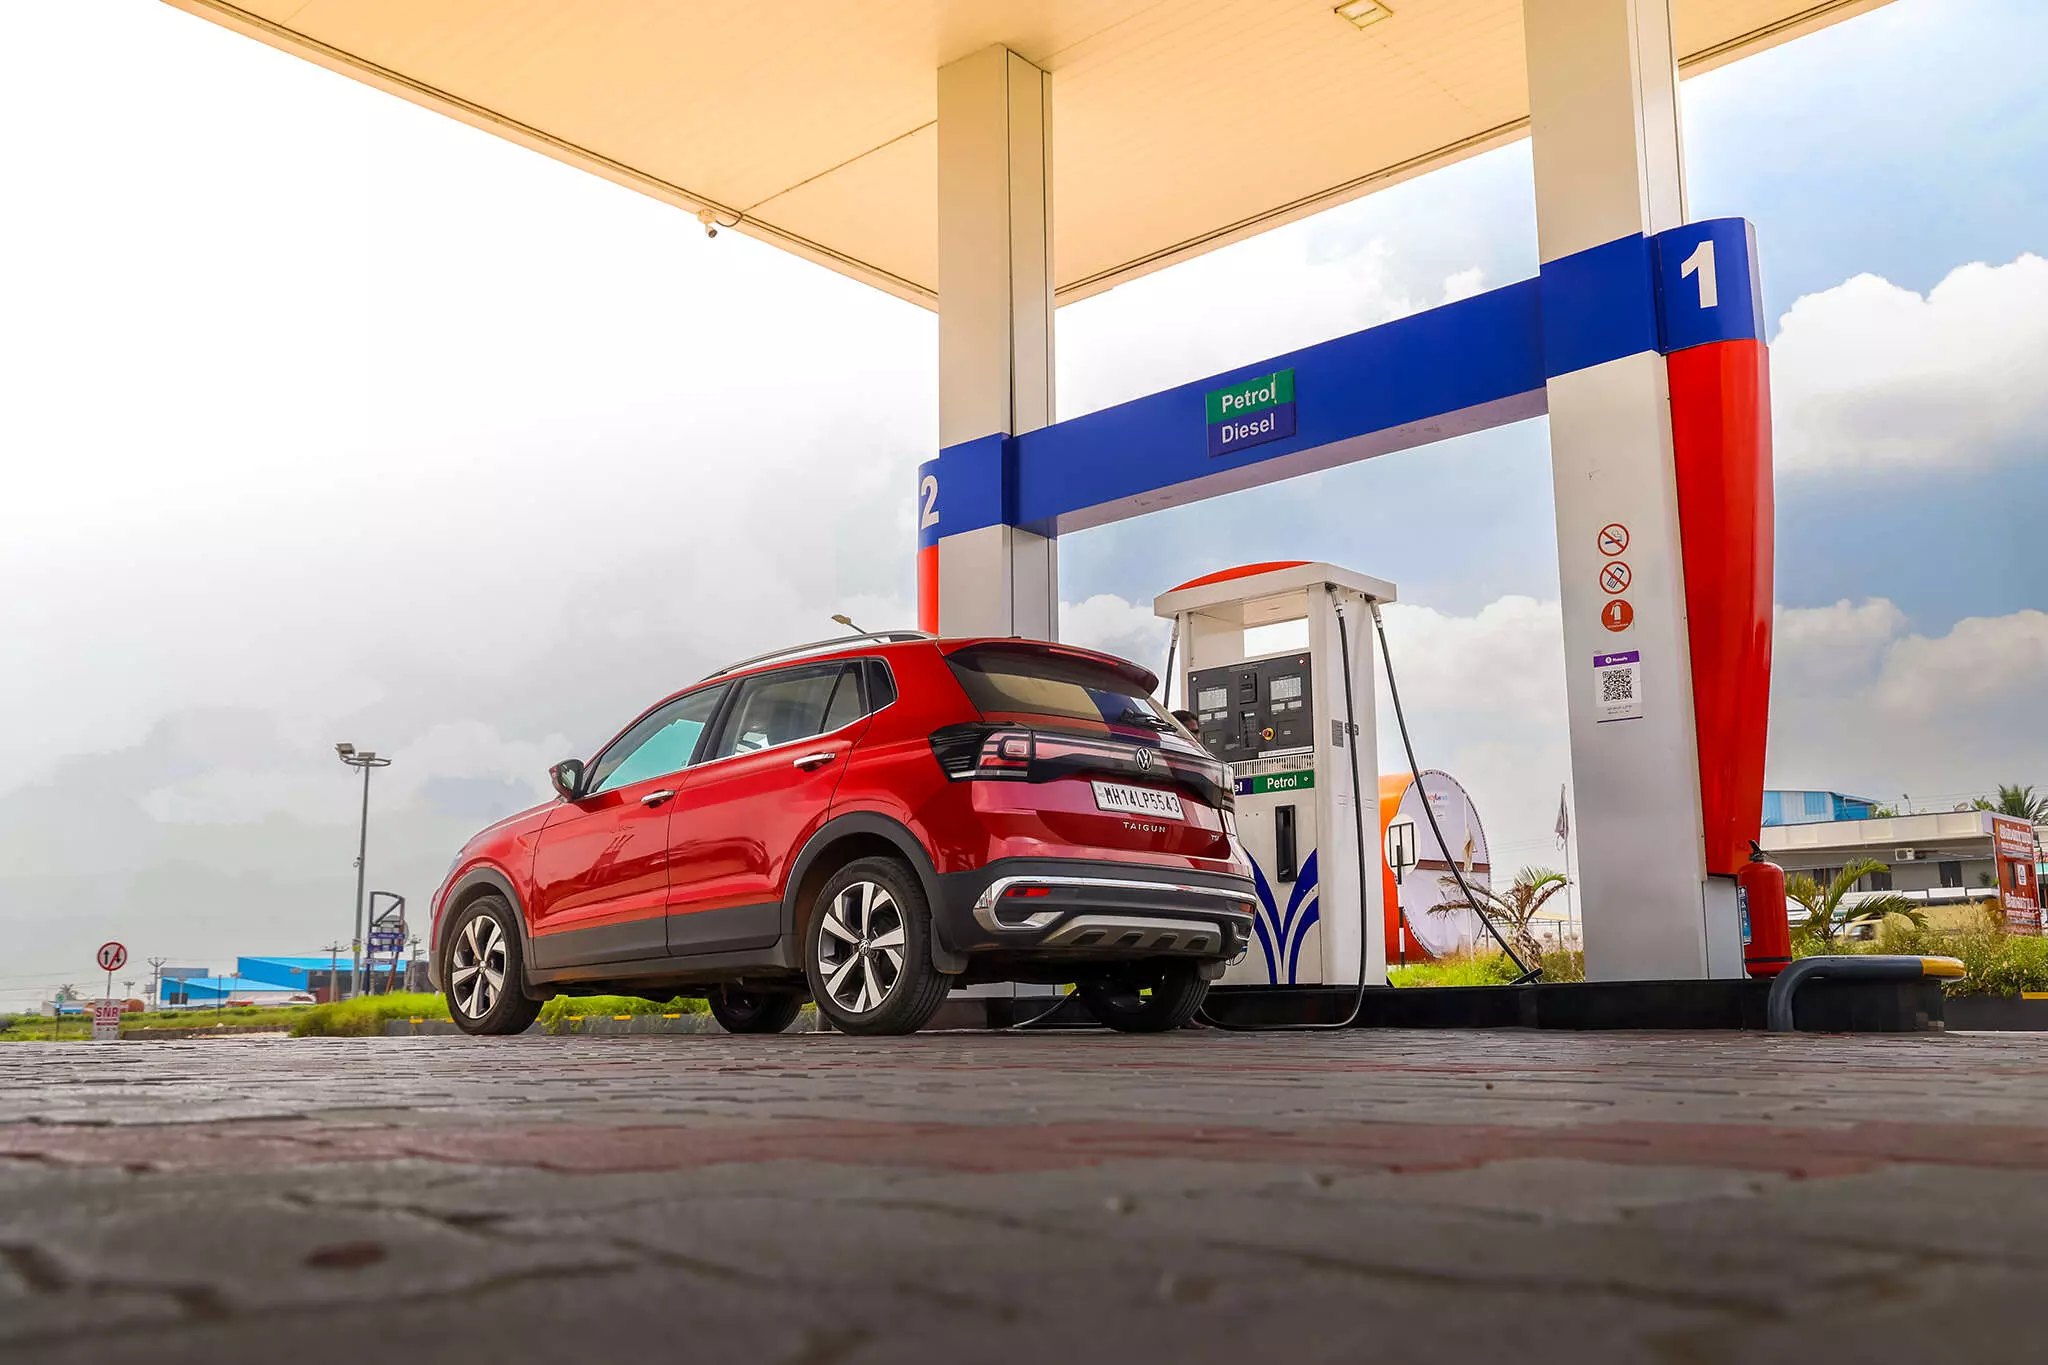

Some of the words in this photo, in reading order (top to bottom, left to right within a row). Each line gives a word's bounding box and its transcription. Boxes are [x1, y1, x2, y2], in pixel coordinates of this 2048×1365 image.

[1681, 240, 1718, 309] 1
[1222, 382, 1275, 413] Petrol
[1222, 412, 1275, 444] Diesel
[921, 475, 939, 529] 2
[1267, 775, 1297, 789] Petrol
[1104, 786, 1180, 813] MH14LP5543
[1122, 821, 1166, 833] TAIGUN
